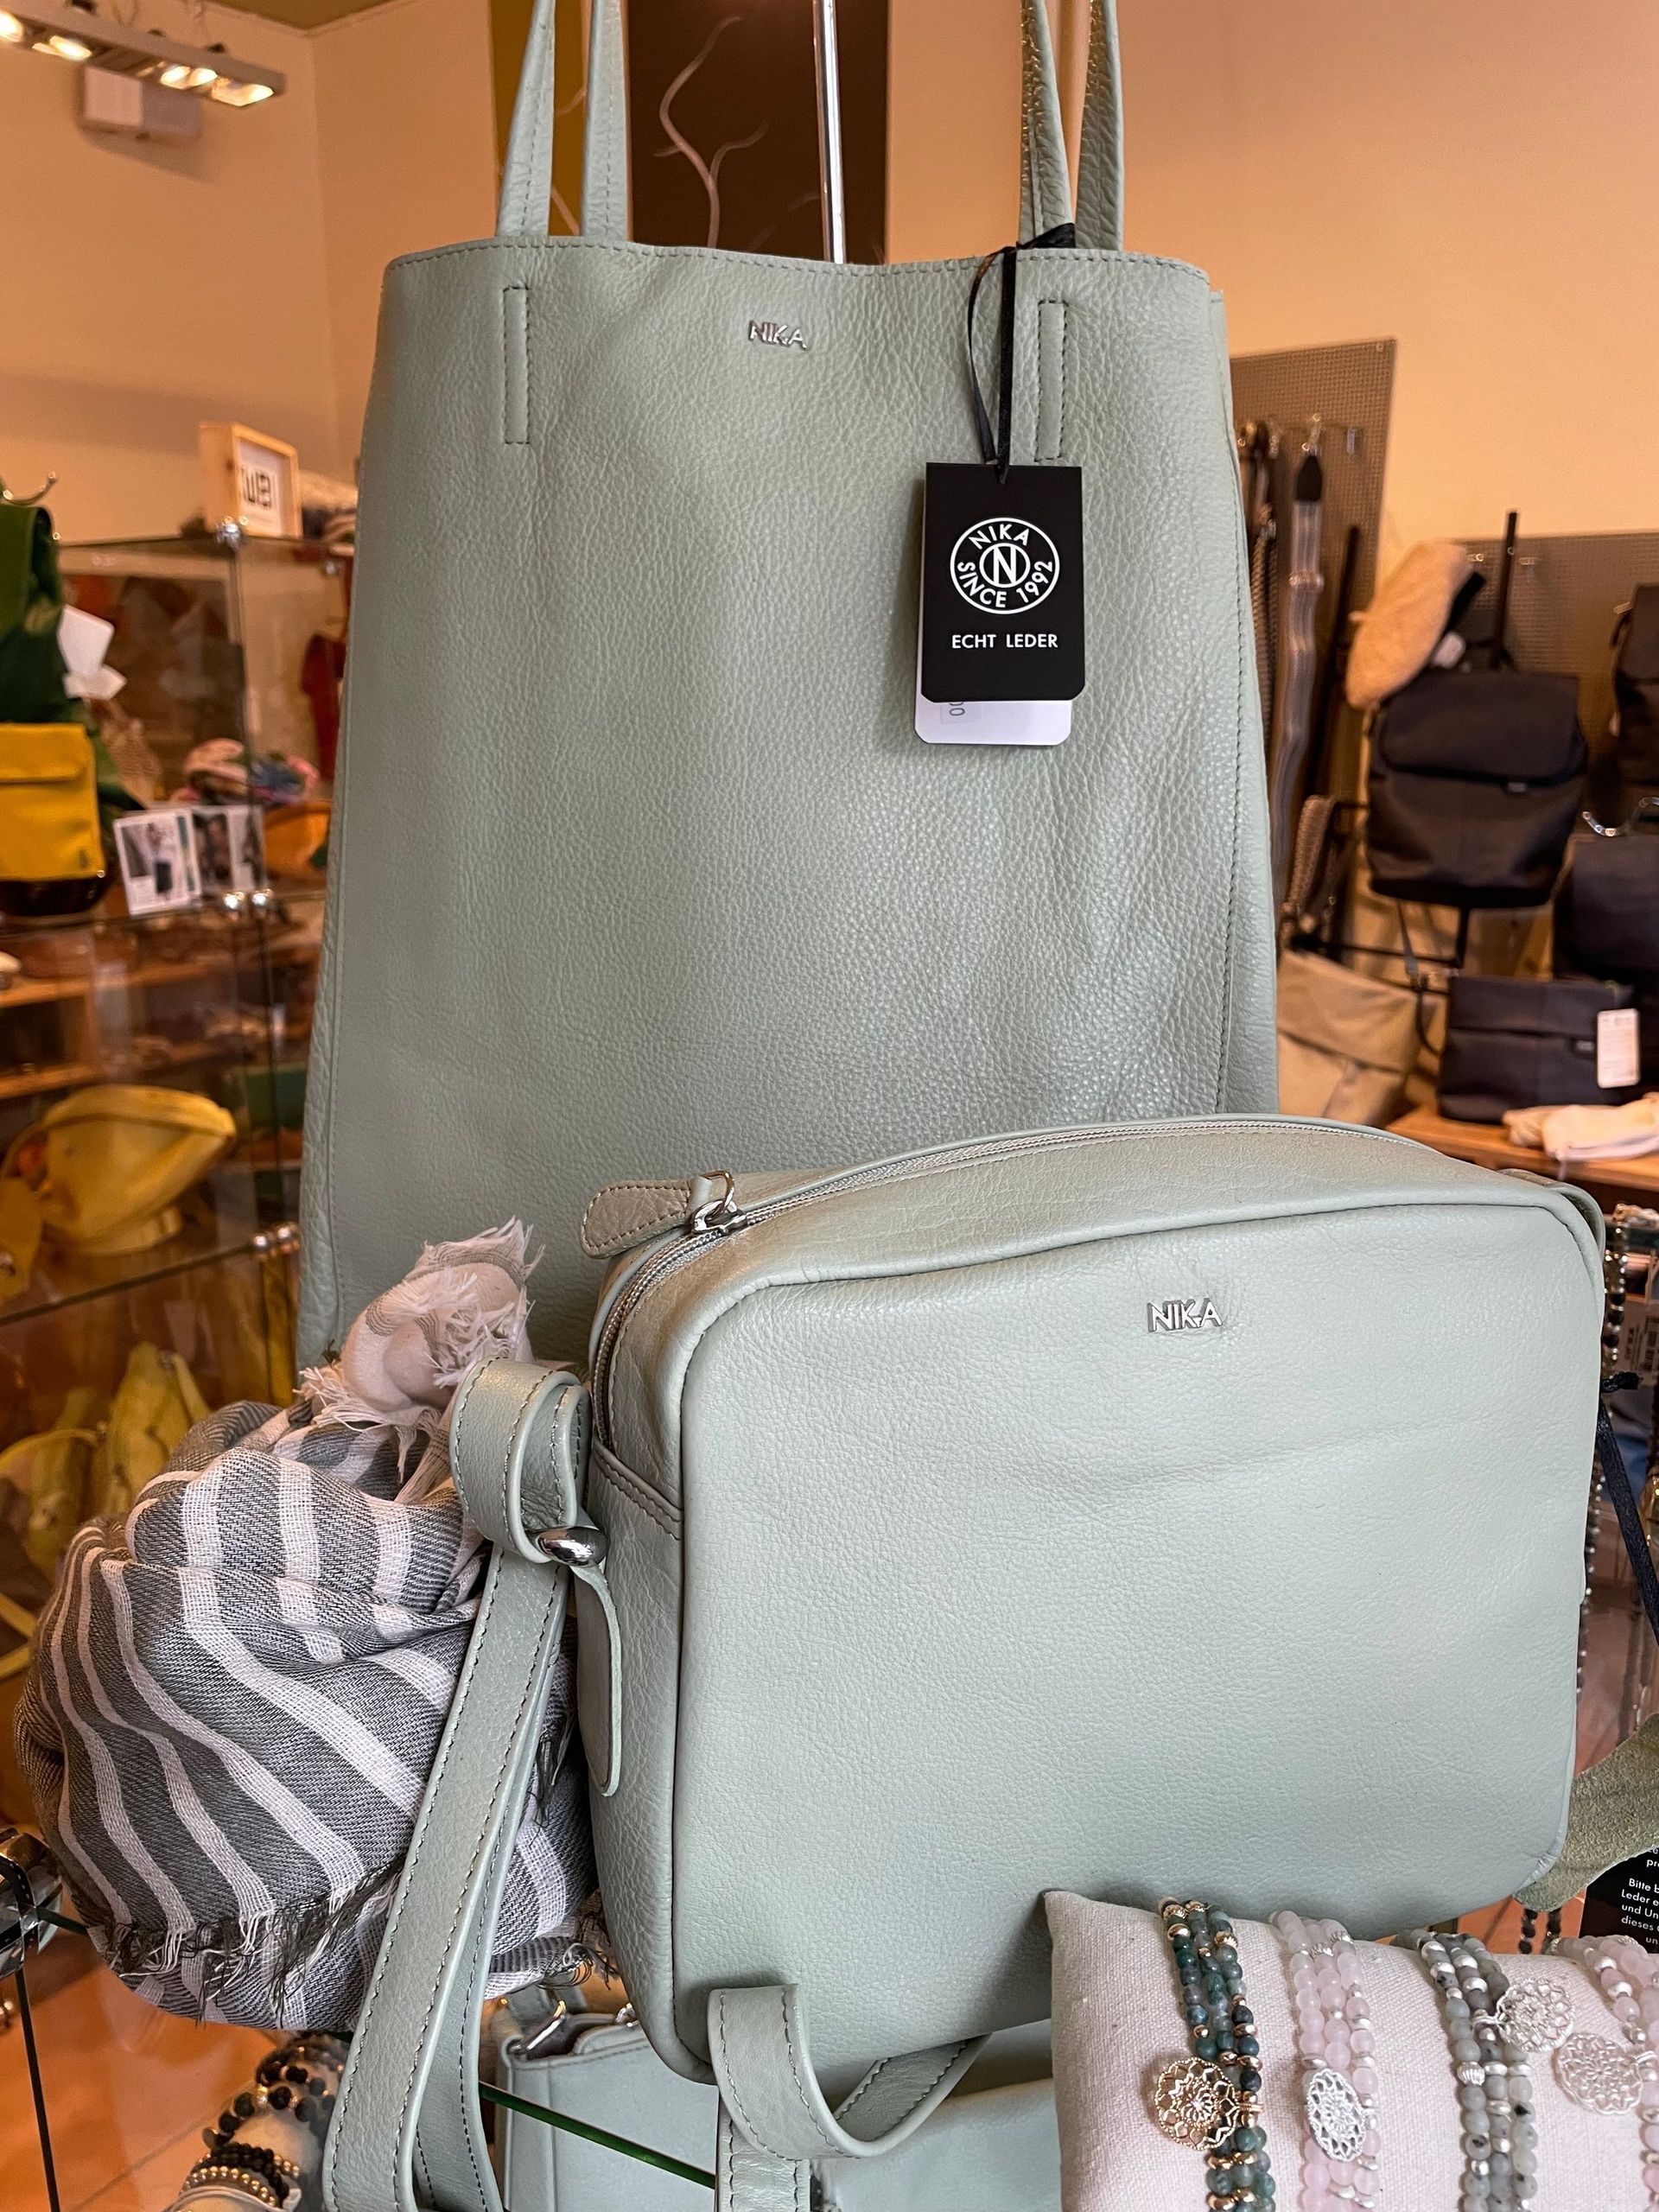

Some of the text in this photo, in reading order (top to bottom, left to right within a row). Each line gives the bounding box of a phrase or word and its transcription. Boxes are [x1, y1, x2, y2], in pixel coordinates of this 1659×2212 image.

[748, 320, 808, 352] NIKA
[968, 524, 1029, 550] NIKA
[993, 545, 1017, 585] N
[957, 561, 1053, 607] SINCE 1992
[951, 633, 1058, 649] ECHT LEDER
[1147, 1298, 1223, 1332] NIKA
[1629, 1878, 1651, 1891] Bitte
[1621, 1889, 1650, 1904] Leder
[1621, 1904, 1642, 1915] und
[1621, 1915, 1654, 1931] dieses
